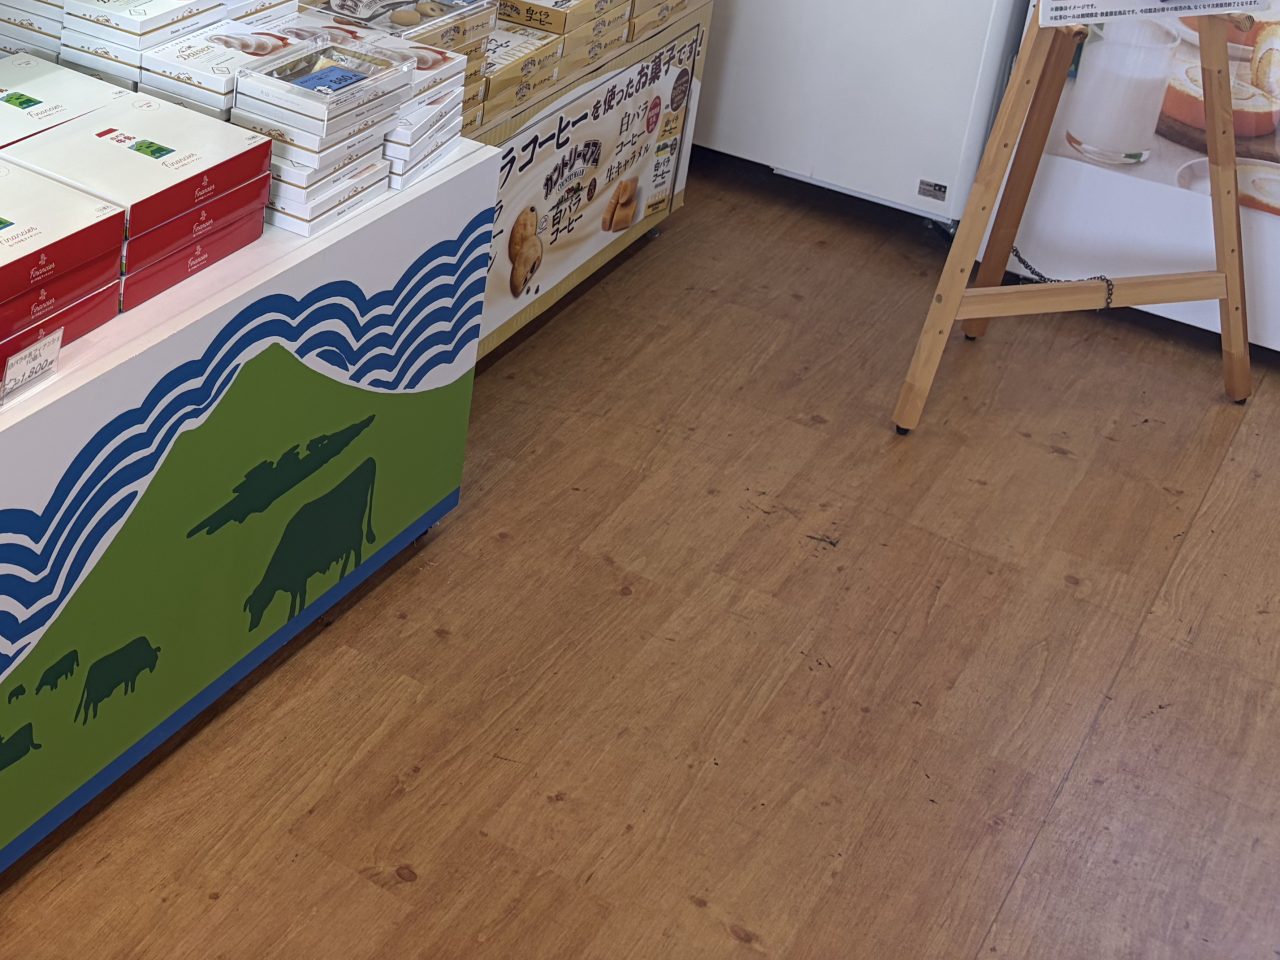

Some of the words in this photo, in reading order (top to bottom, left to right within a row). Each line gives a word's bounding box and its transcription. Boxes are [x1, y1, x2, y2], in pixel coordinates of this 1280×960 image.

[615, 130, 646, 156] コーヒー
[606, 143, 651, 183] 生キャラメル
[549, 214, 583, 245] コーヒー
